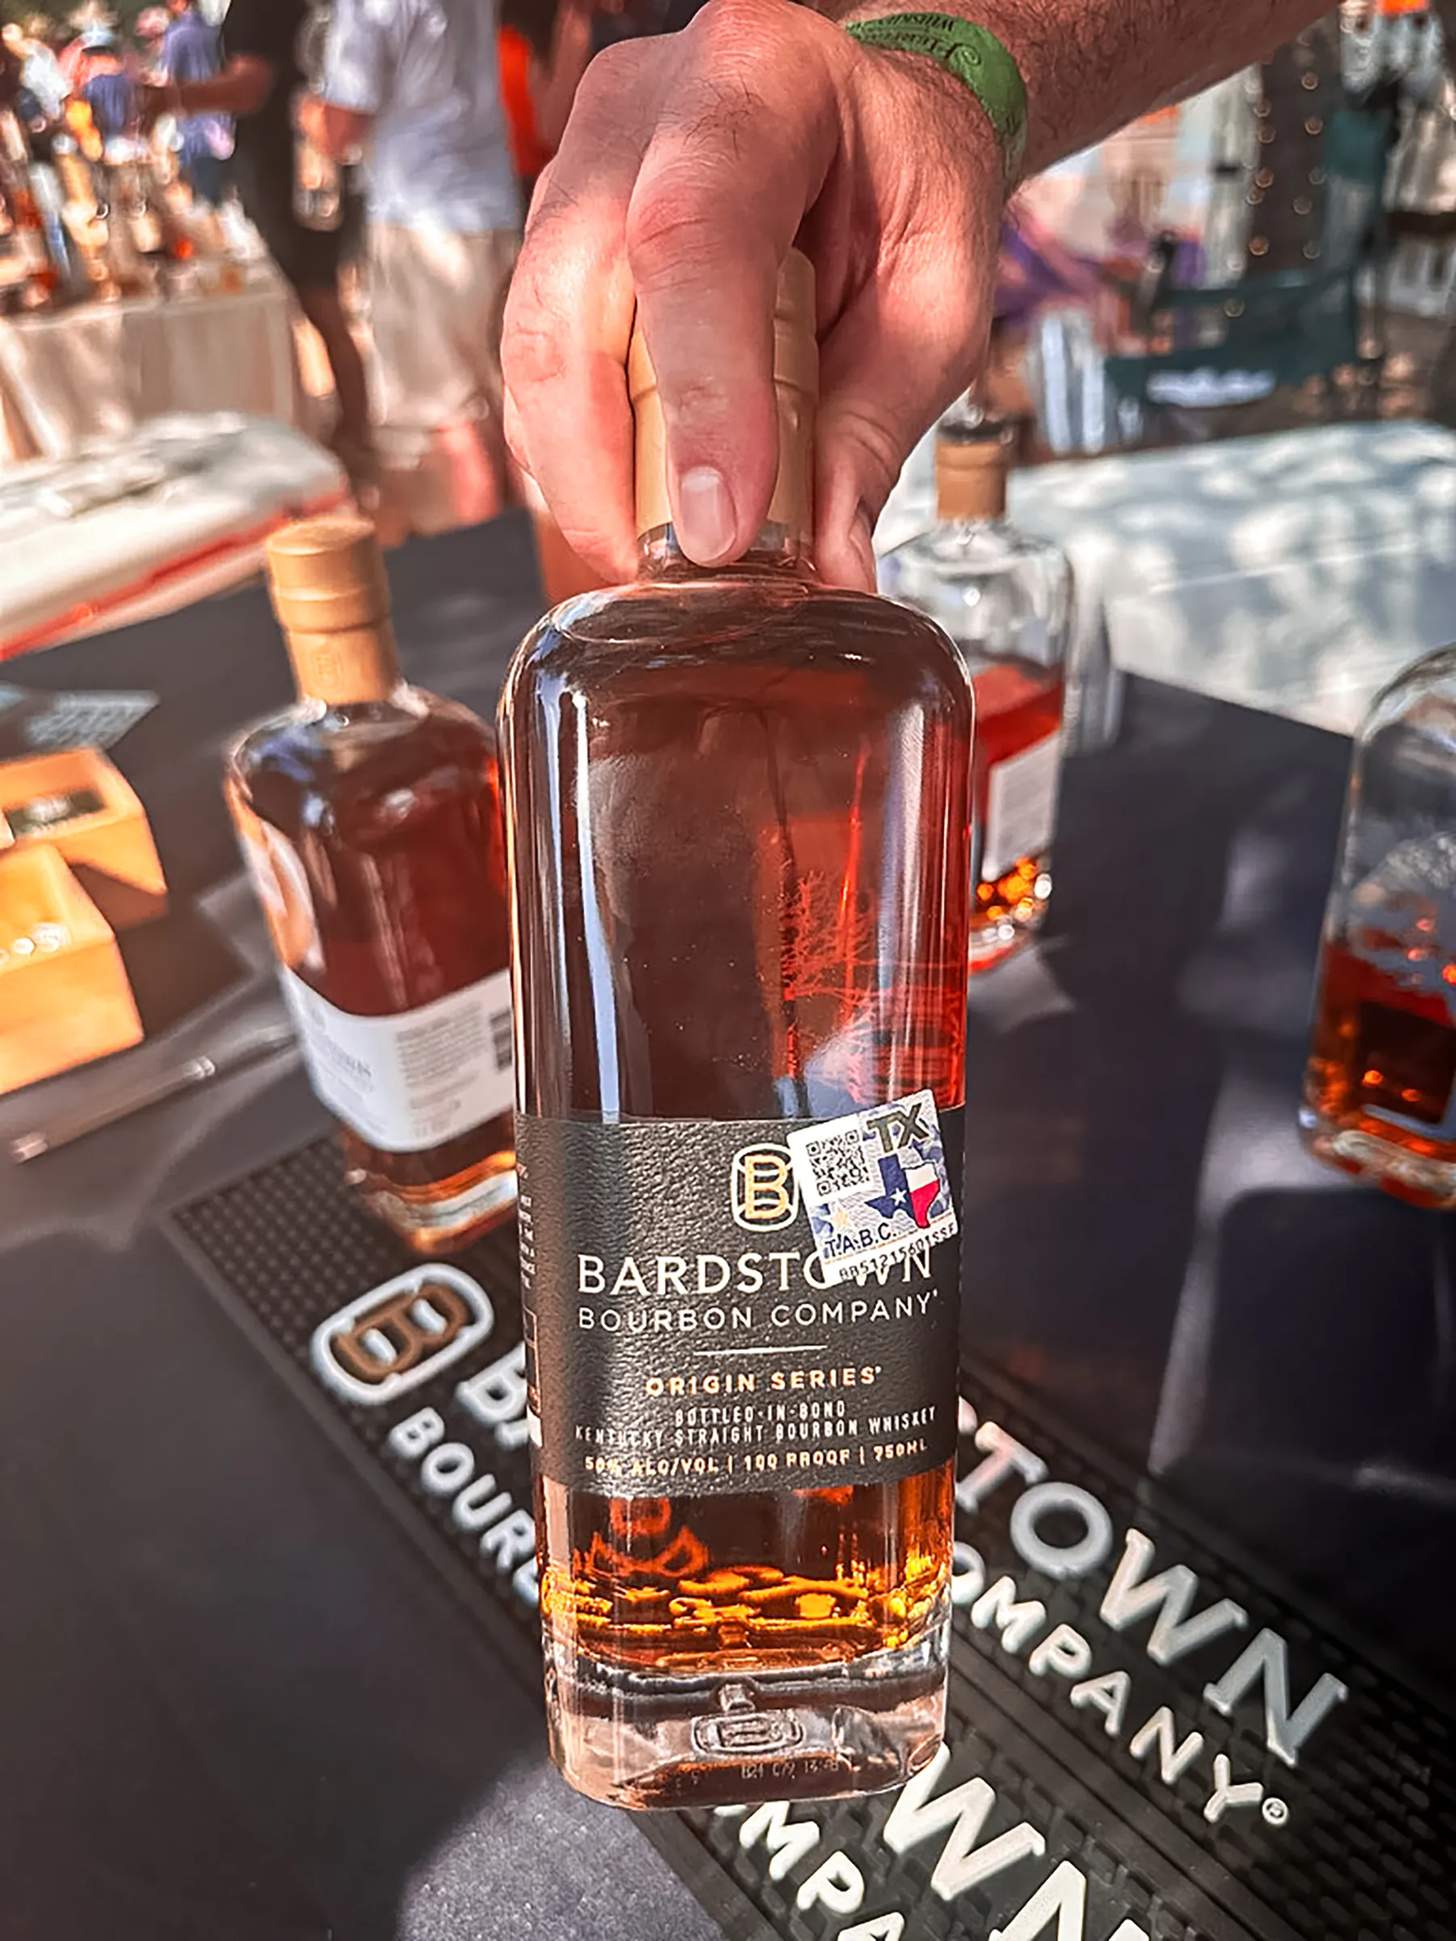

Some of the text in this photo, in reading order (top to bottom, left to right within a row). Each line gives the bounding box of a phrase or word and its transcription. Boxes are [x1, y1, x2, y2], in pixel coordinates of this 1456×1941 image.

[866, 1103, 929, 1151] TX
[744, 1154, 789, 1219] B
[577, 1253, 931, 1296] BARDSTON
[578, 1307, 752, 1334] BOURBON
[645, 1374, 755, 1397] ORIGIN
[674, 1424, 763, 1447] STRAIGHT
[776, 1419, 858, 1443] BOURBON
[868, 1405, 936, 1435] WHISKEY
[786, 1449, 850, 1470] PROOF
[956, 1396, 1348, 1768] TOWN
